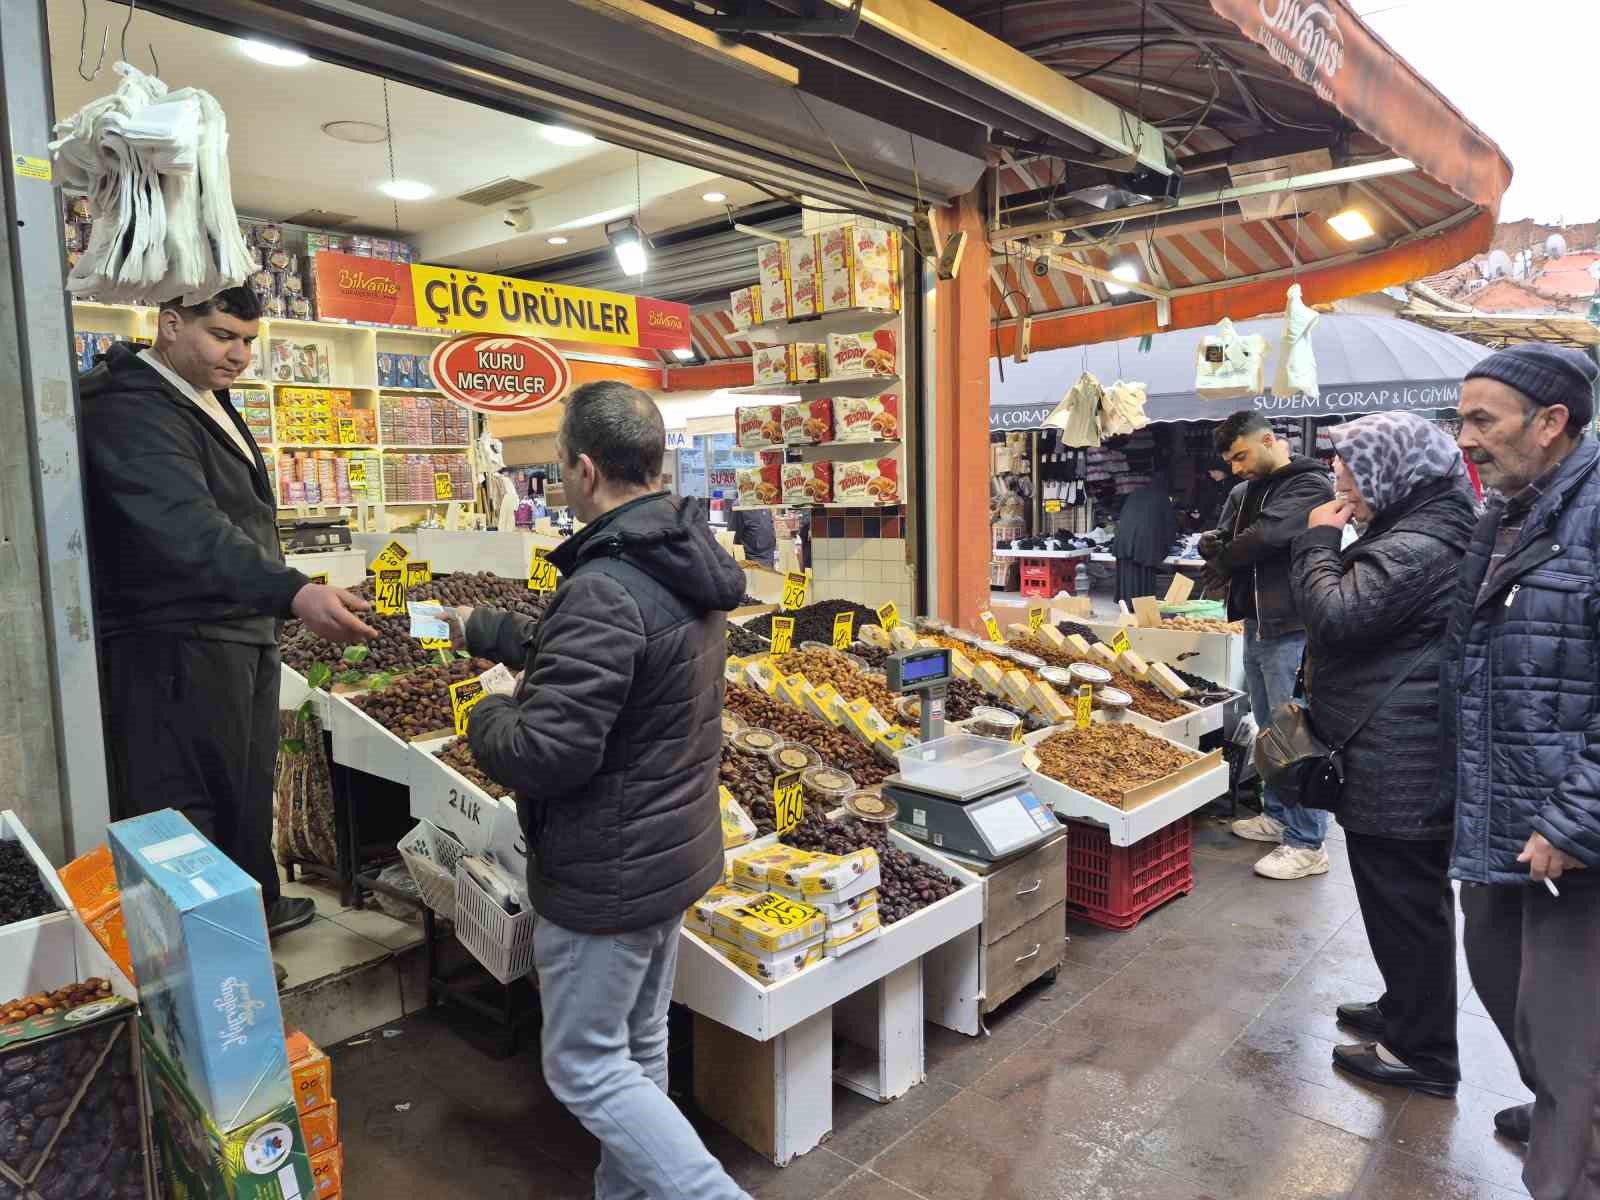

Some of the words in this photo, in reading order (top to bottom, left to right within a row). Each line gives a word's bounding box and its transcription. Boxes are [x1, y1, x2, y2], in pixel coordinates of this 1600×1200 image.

[425, 273, 488, 324] ÇİĞ
[498, 281, 631, 335] ÜRÜNLER
[478, 351, 524, 371] KURU
[457, 371, 545, 394] MEYVELER
[1325, 390, 1389, 409] ÇORAP
[1002, 409, 1049, 426] ÇORAP
[530, 562, 557, 588] 480
[378, 583, 403, 608] 420
[778, 788, 804, 831] 160
